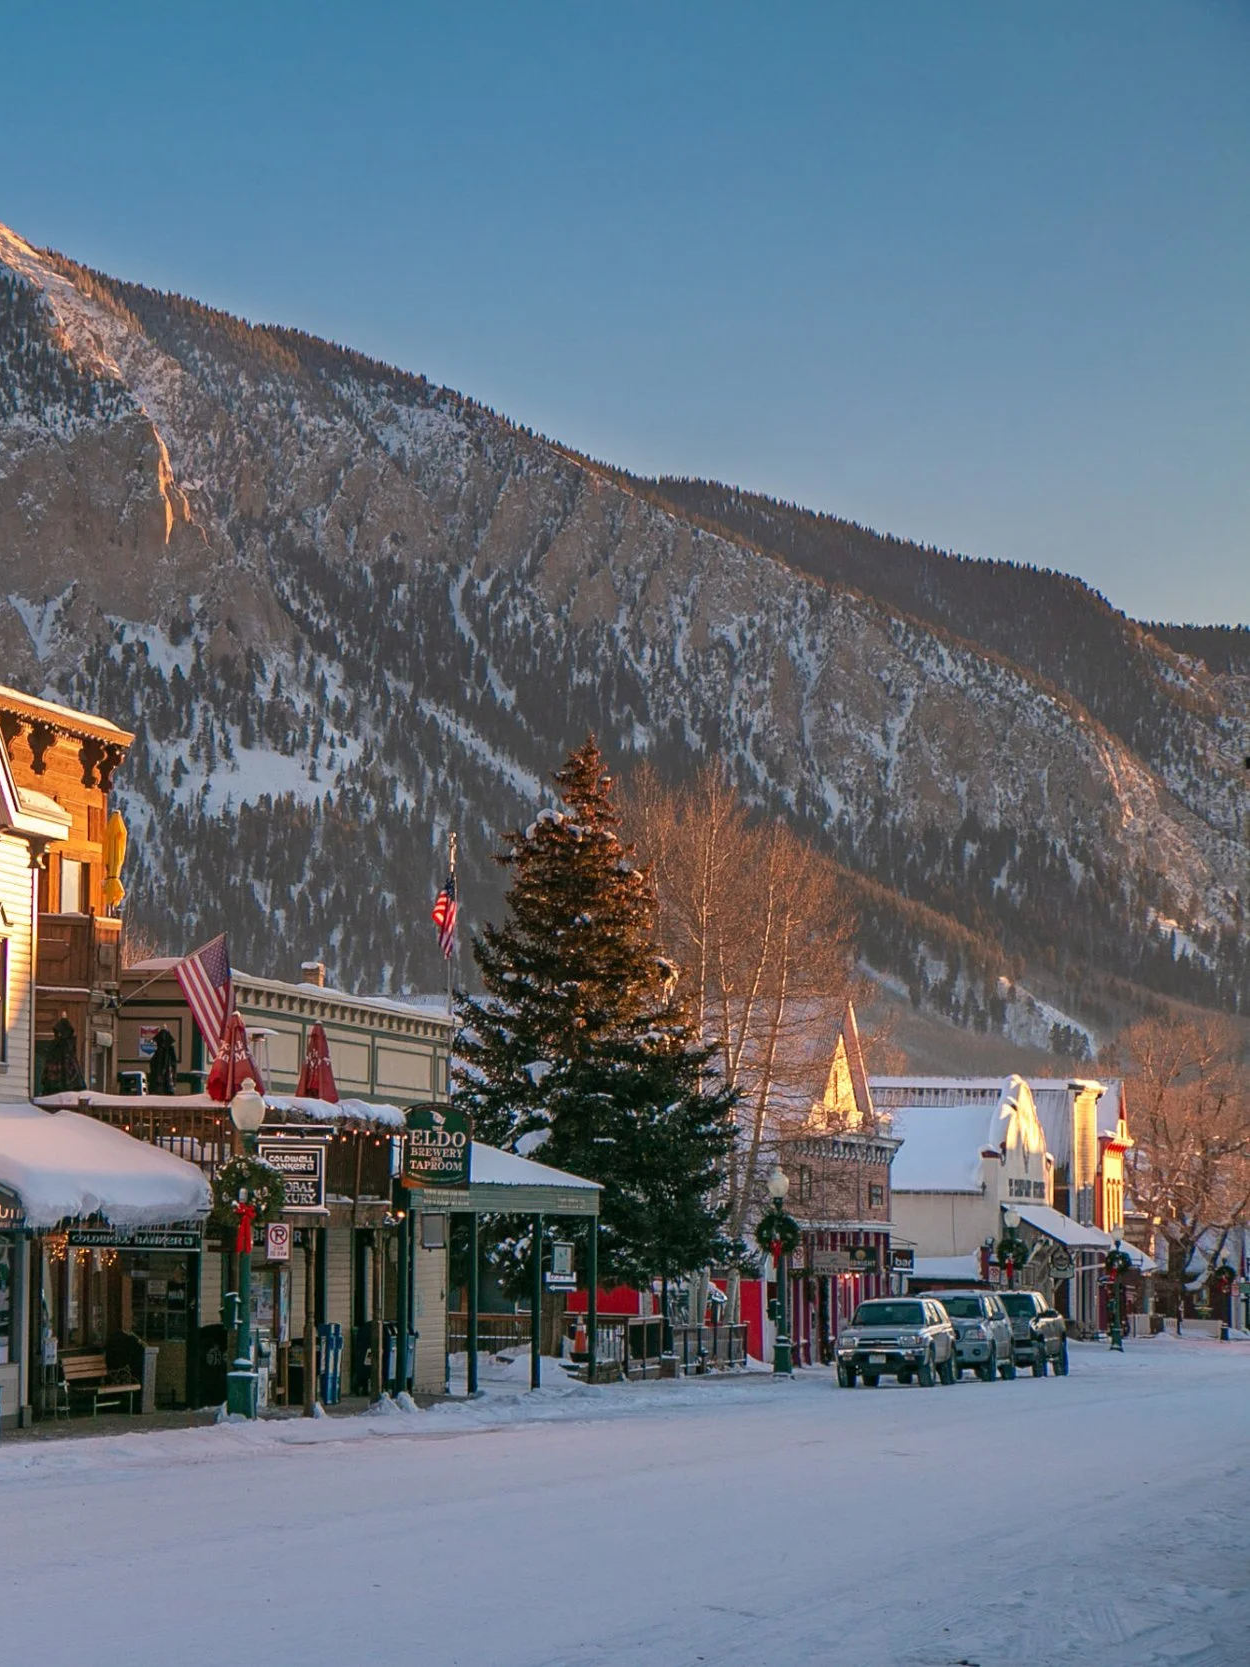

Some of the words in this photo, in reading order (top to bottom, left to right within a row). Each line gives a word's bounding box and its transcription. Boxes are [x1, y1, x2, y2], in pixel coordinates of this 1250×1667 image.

[409, 1130, 466, 1148] ELDO
[411, 1147, 464, 1158] BREWERY
[410, 1160, 462, 1171] TAPROOM
